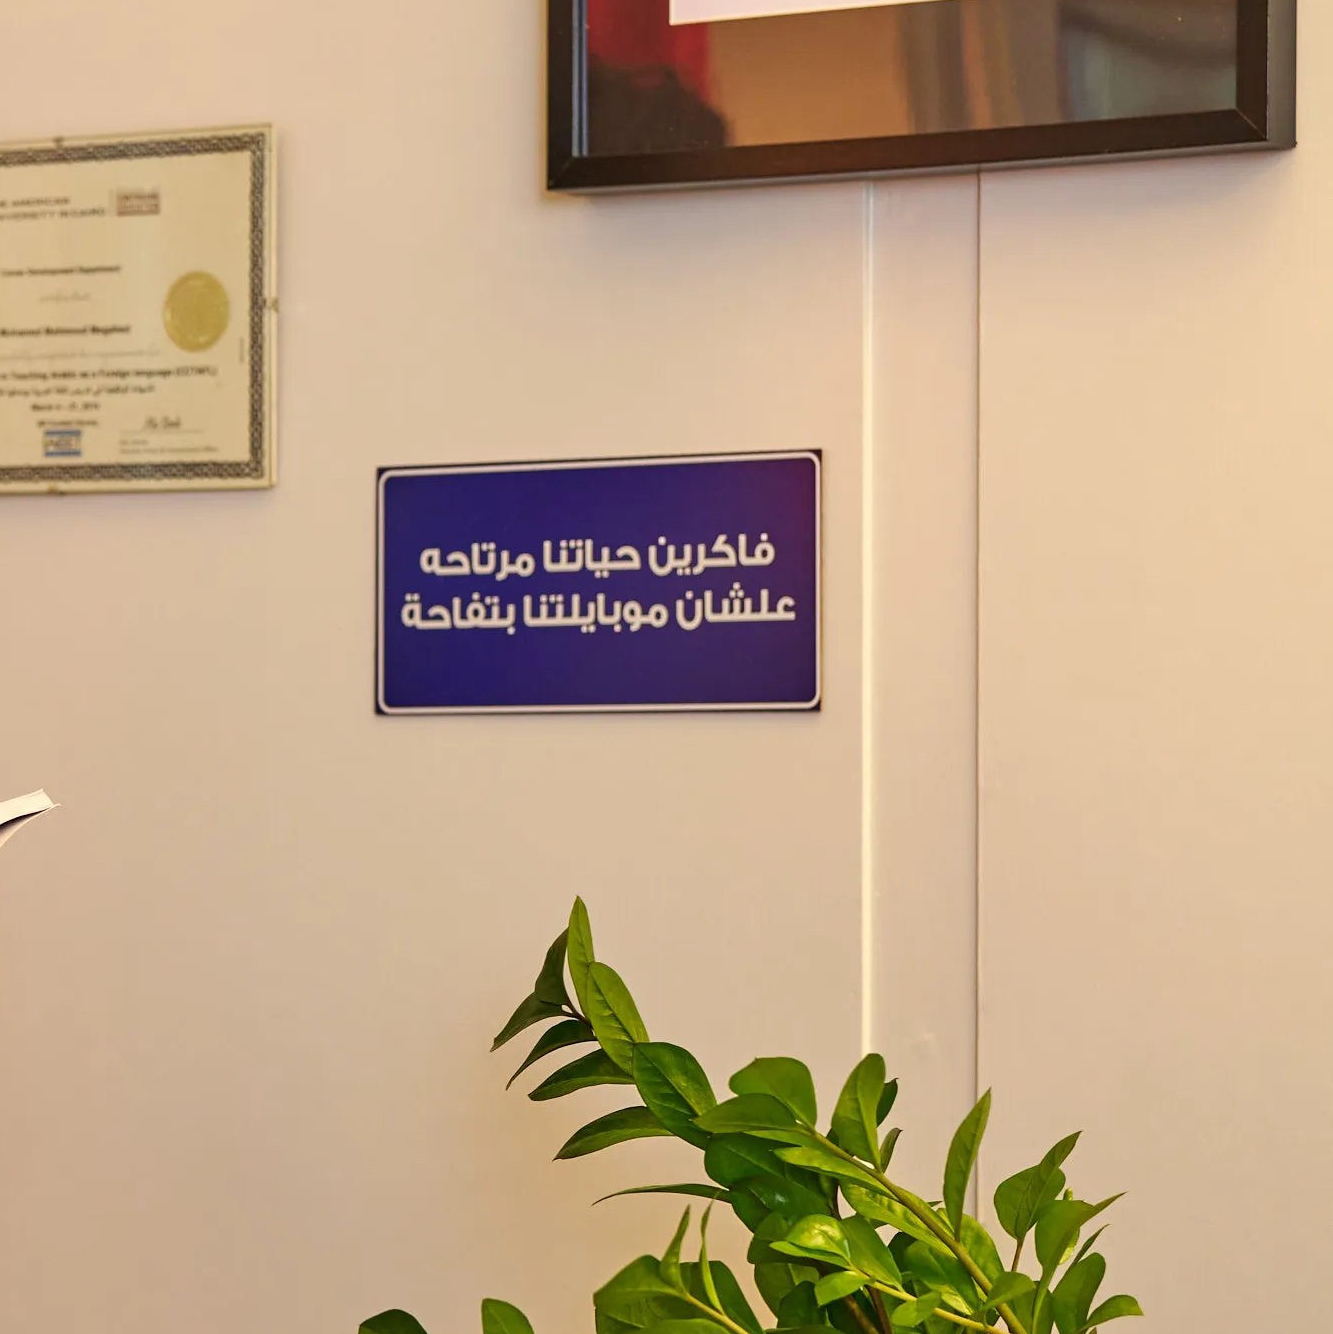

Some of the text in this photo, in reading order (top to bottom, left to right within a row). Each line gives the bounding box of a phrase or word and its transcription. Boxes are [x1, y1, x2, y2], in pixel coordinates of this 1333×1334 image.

[419, 532, 776, 581] فاكرين حياتنا مرتاحه
[400, 581, 796, 635] علشان موبايلتنا بتفاحة
